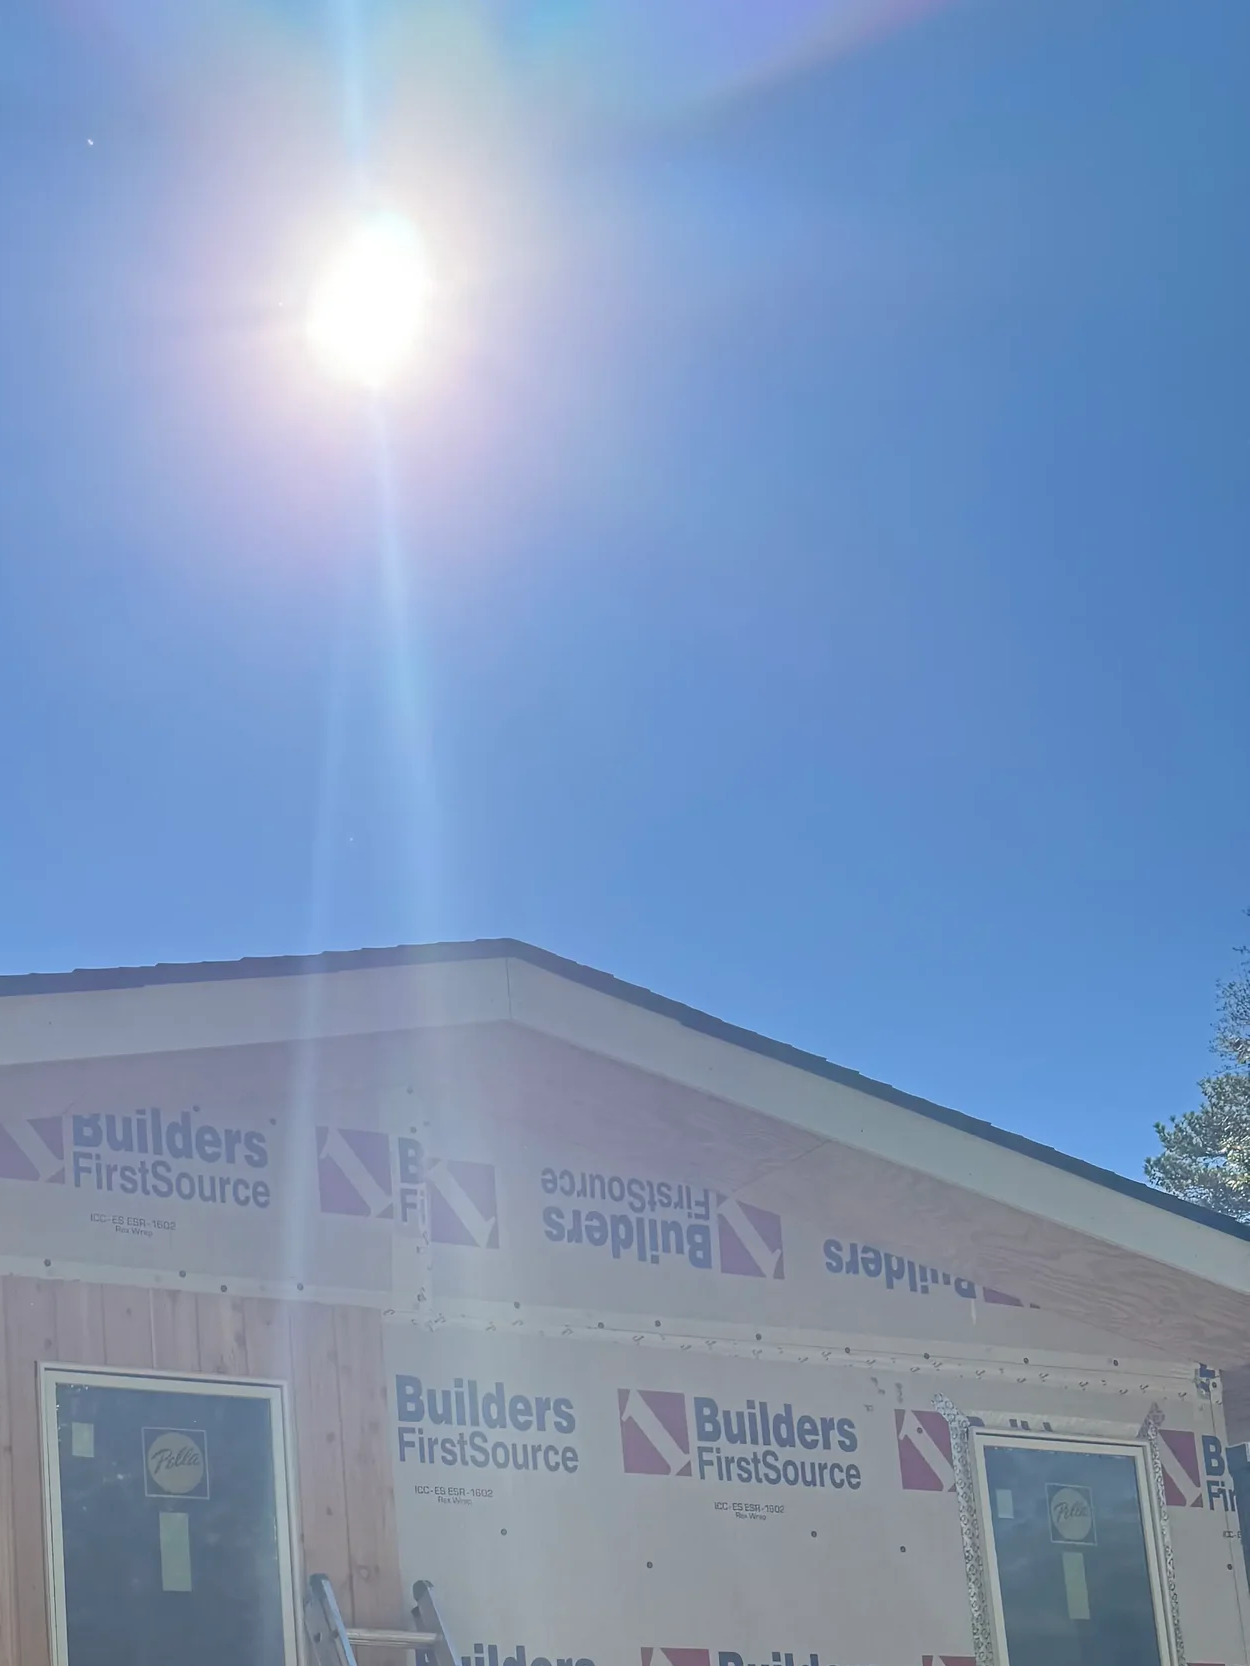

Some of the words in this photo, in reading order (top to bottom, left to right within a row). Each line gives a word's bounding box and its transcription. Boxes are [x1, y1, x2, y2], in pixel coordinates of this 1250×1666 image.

[72, 1106, 269, 1169] Builders
[72, 1150, 271, 1209] FirstSource
[540, 1167, 710, 1221] FirstSource
[90, 1213, 124, 1225] ICC-ES
[542, 1205, 713, 1269] Builders
[395, 1374, 576, 1434] Builders
[693, 1396, 858, 1453] Builders
[397, 1426, 579, 1474] FirstSource
[697, 1446, 862, 1490] FirstSource
[414, 1485, 446, 1495] ICC-ES
